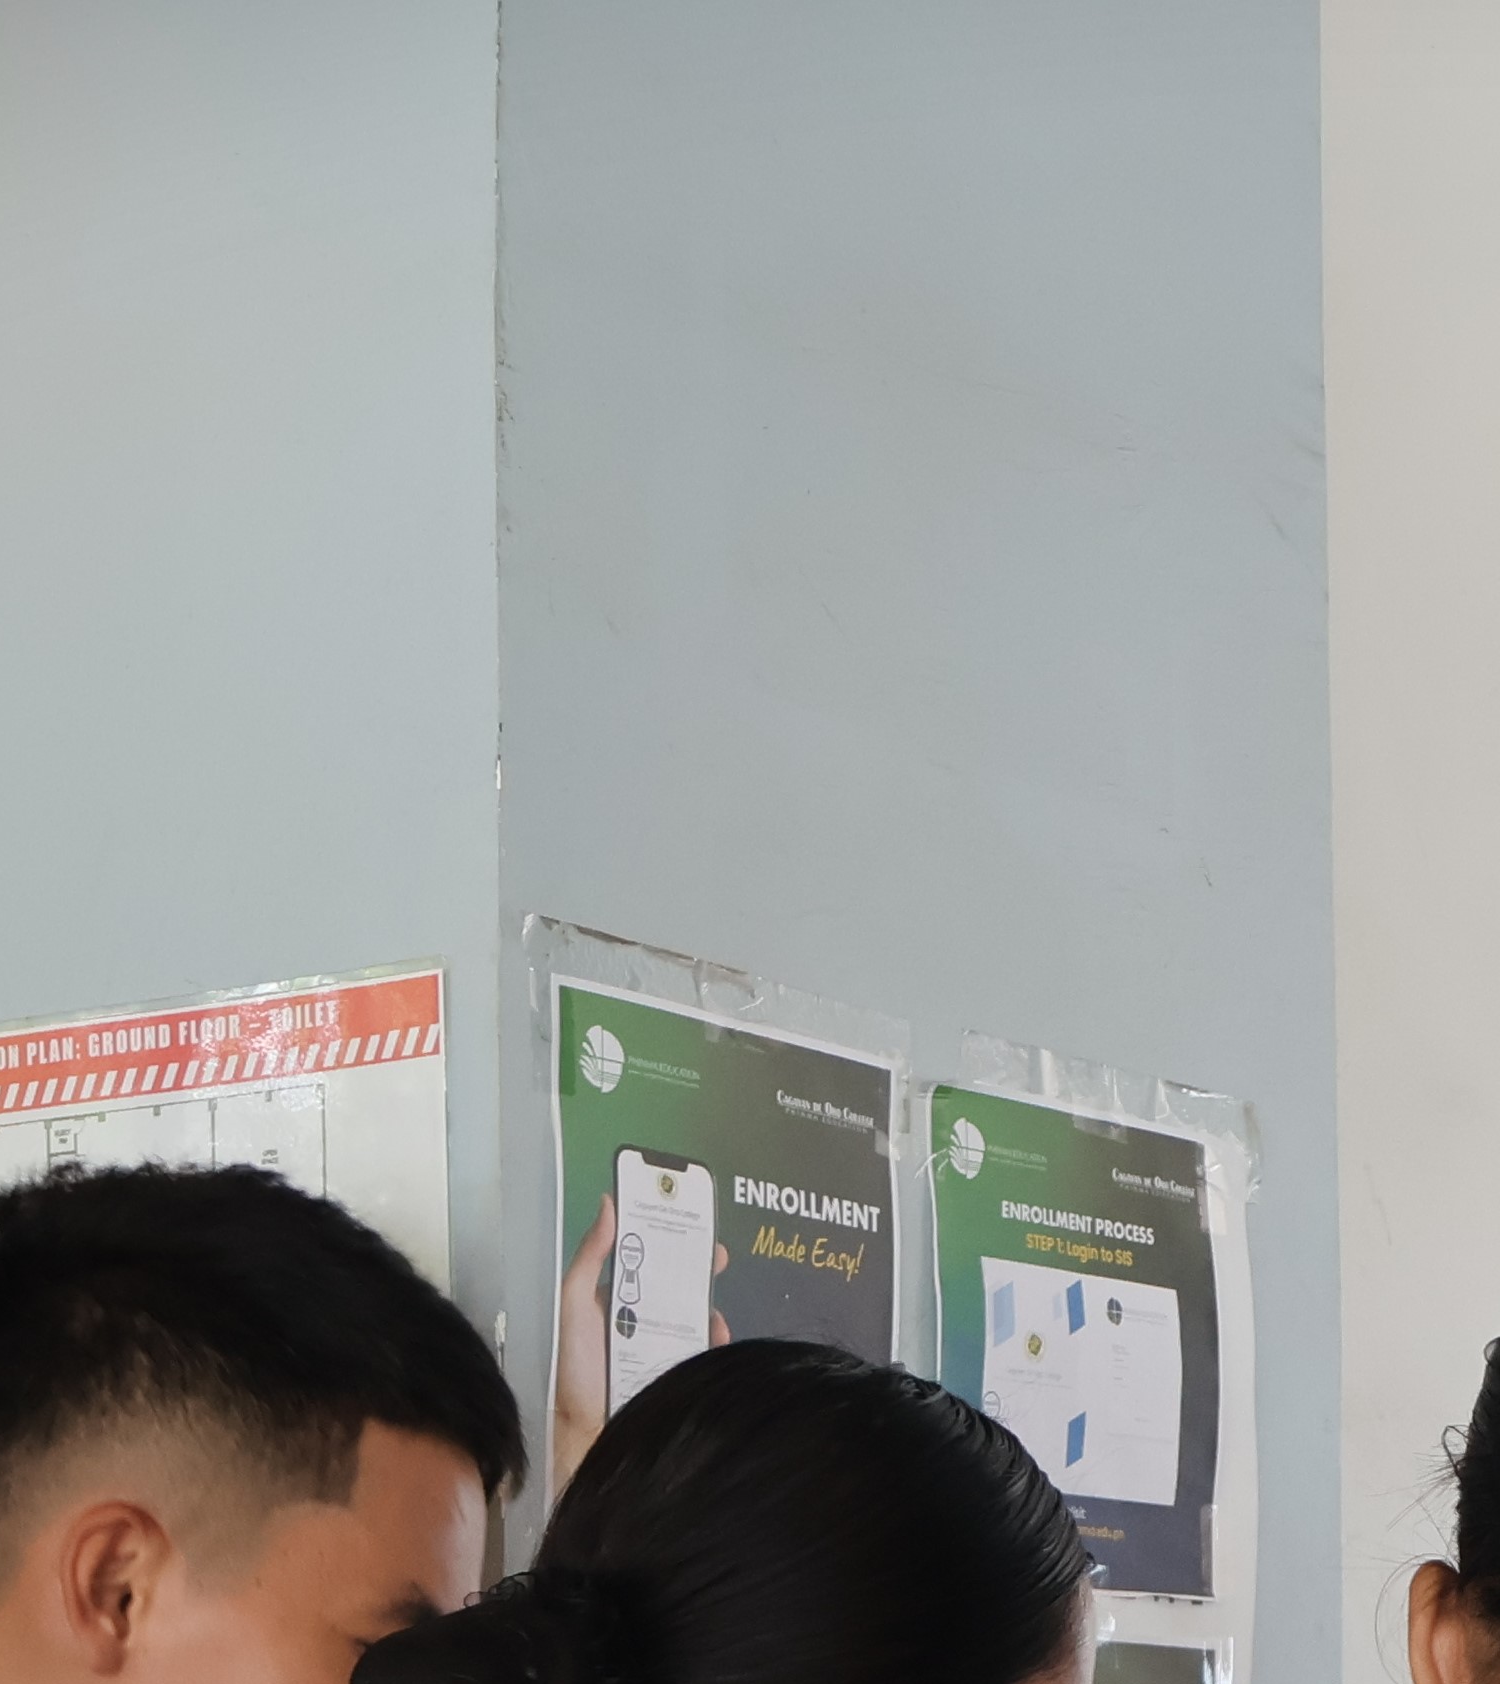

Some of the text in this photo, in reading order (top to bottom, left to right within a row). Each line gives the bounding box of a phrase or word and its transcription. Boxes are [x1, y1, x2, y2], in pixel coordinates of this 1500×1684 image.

[26, 1036, 82, 1066] PLAN:
[88, 1024, 171, 1058] GROUND
[178, 1014, 241, 1045] FLOOR
[267, 1001, 338, 1033] TOILET
[734, 1174, 881, 1233] ENROLLMENT
[1001, 1200, 1155, 1246] ENROLLMENT PROCESS
[751, 1225, 865, 1283] Made Easy!
[1026, 1233, 1055, 1252] STEP
[1066, 1239, 1099, 1264] Login
[1100, 1246, 1113, 1263] to
[1114, 1249, 1134, 1267] SIS
